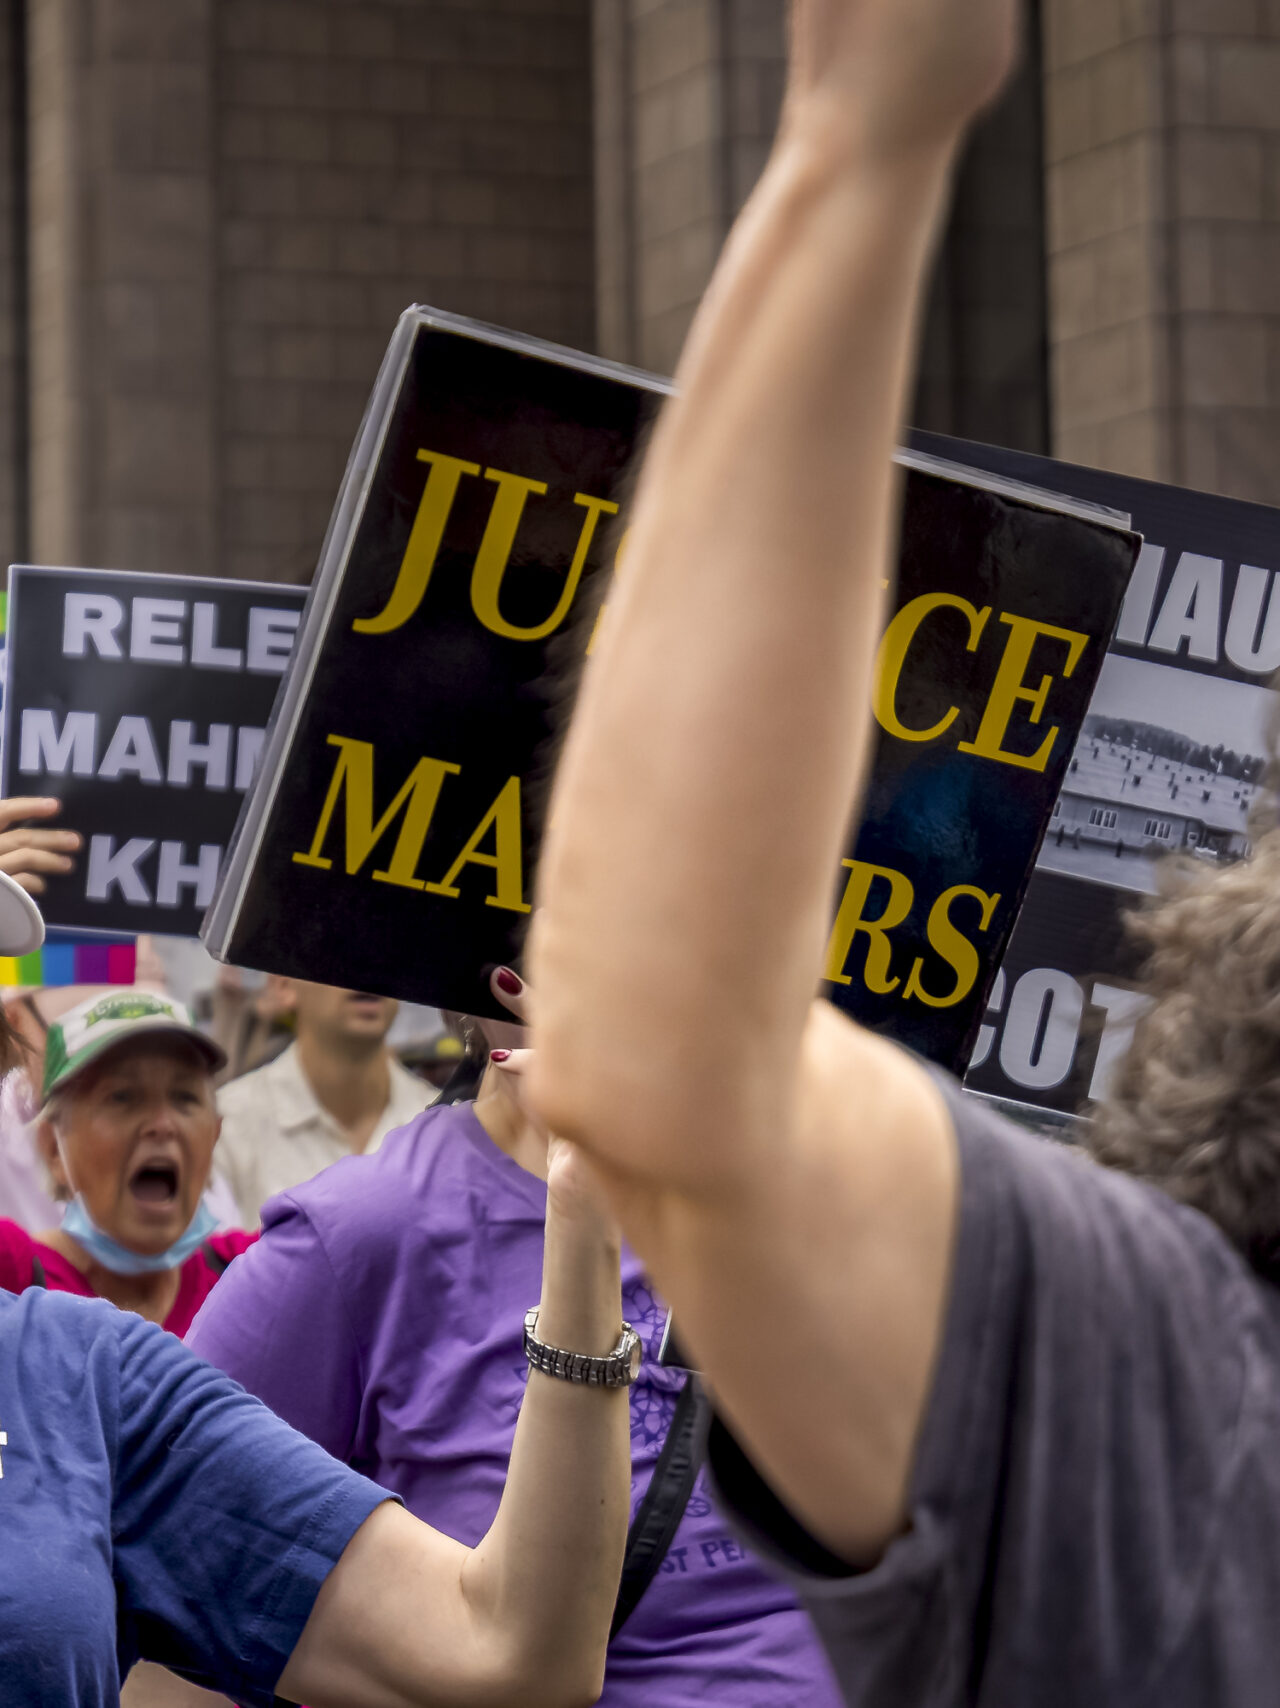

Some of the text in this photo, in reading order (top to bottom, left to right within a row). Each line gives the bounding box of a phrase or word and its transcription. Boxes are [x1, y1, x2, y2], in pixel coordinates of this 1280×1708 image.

[62, 592, 302, 673] RELE
[352, 448, 1090, 773] JUCE
[292, 733, 1001, 1008] MARS
